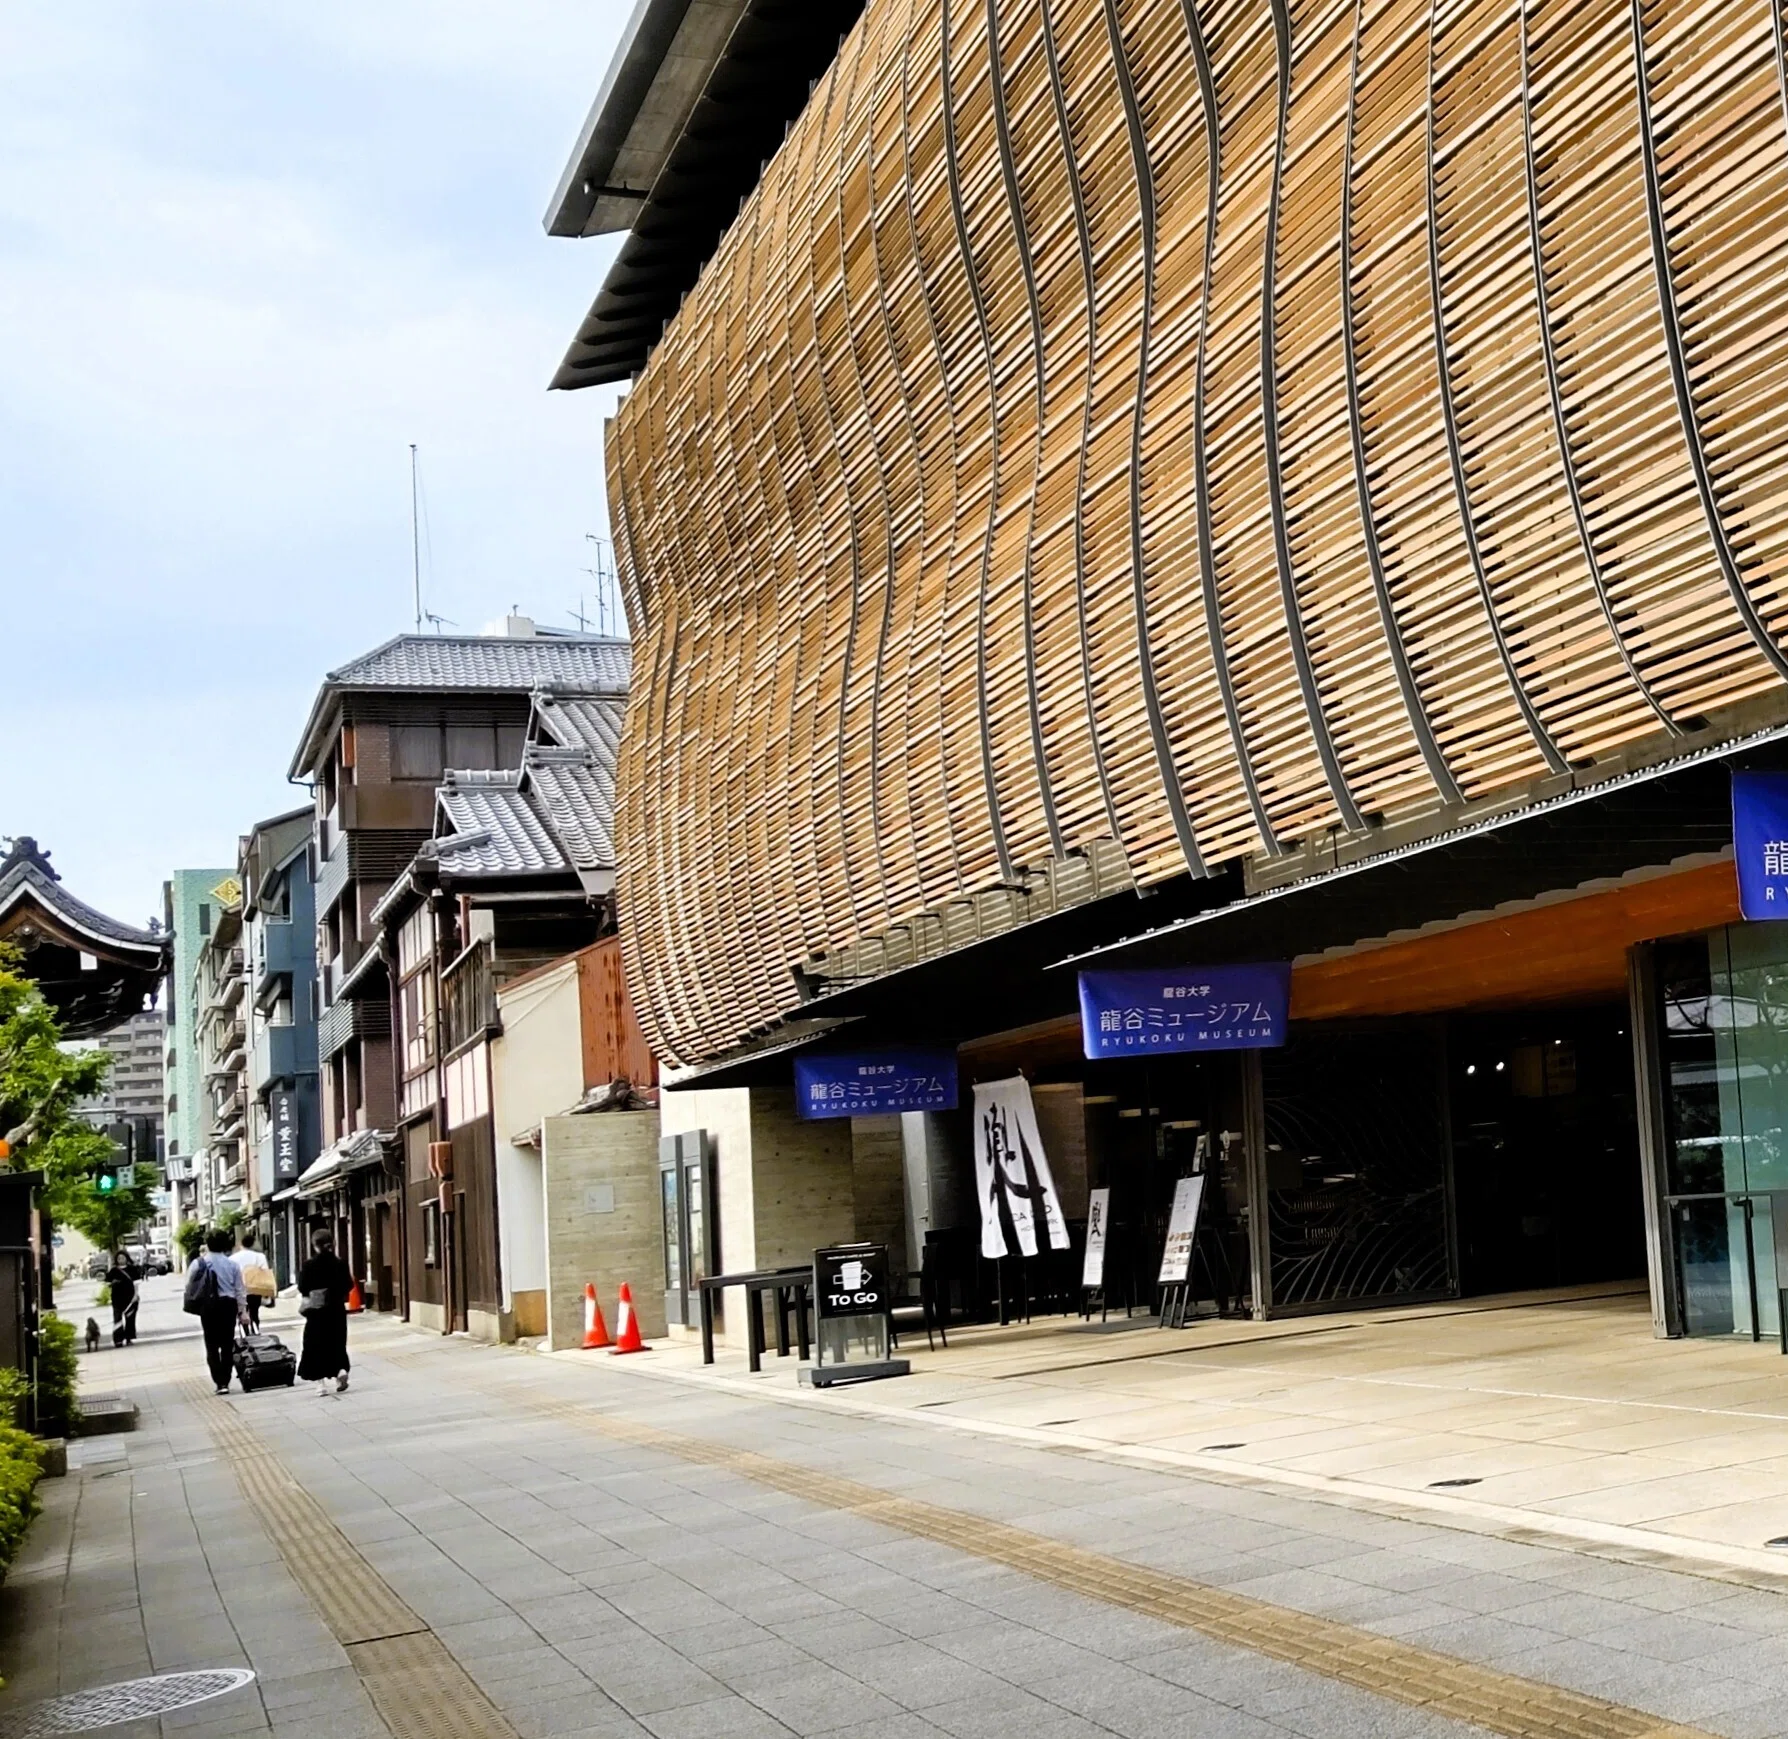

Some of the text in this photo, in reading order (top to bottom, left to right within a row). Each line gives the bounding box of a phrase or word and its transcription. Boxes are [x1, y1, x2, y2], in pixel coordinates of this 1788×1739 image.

[1163, 985, 1211, 999] 龍谷大学
[1099, 1001, 1272, 1032] 龍谷ミュージアム
[1101, 1028, 1272, 1047] RYUKOKU MUSEUM
[810, 1076, 944, 1100] 龍谷ミュージアム
[811, 1096, 944, 1111] RYUKOKU MUSEUM
